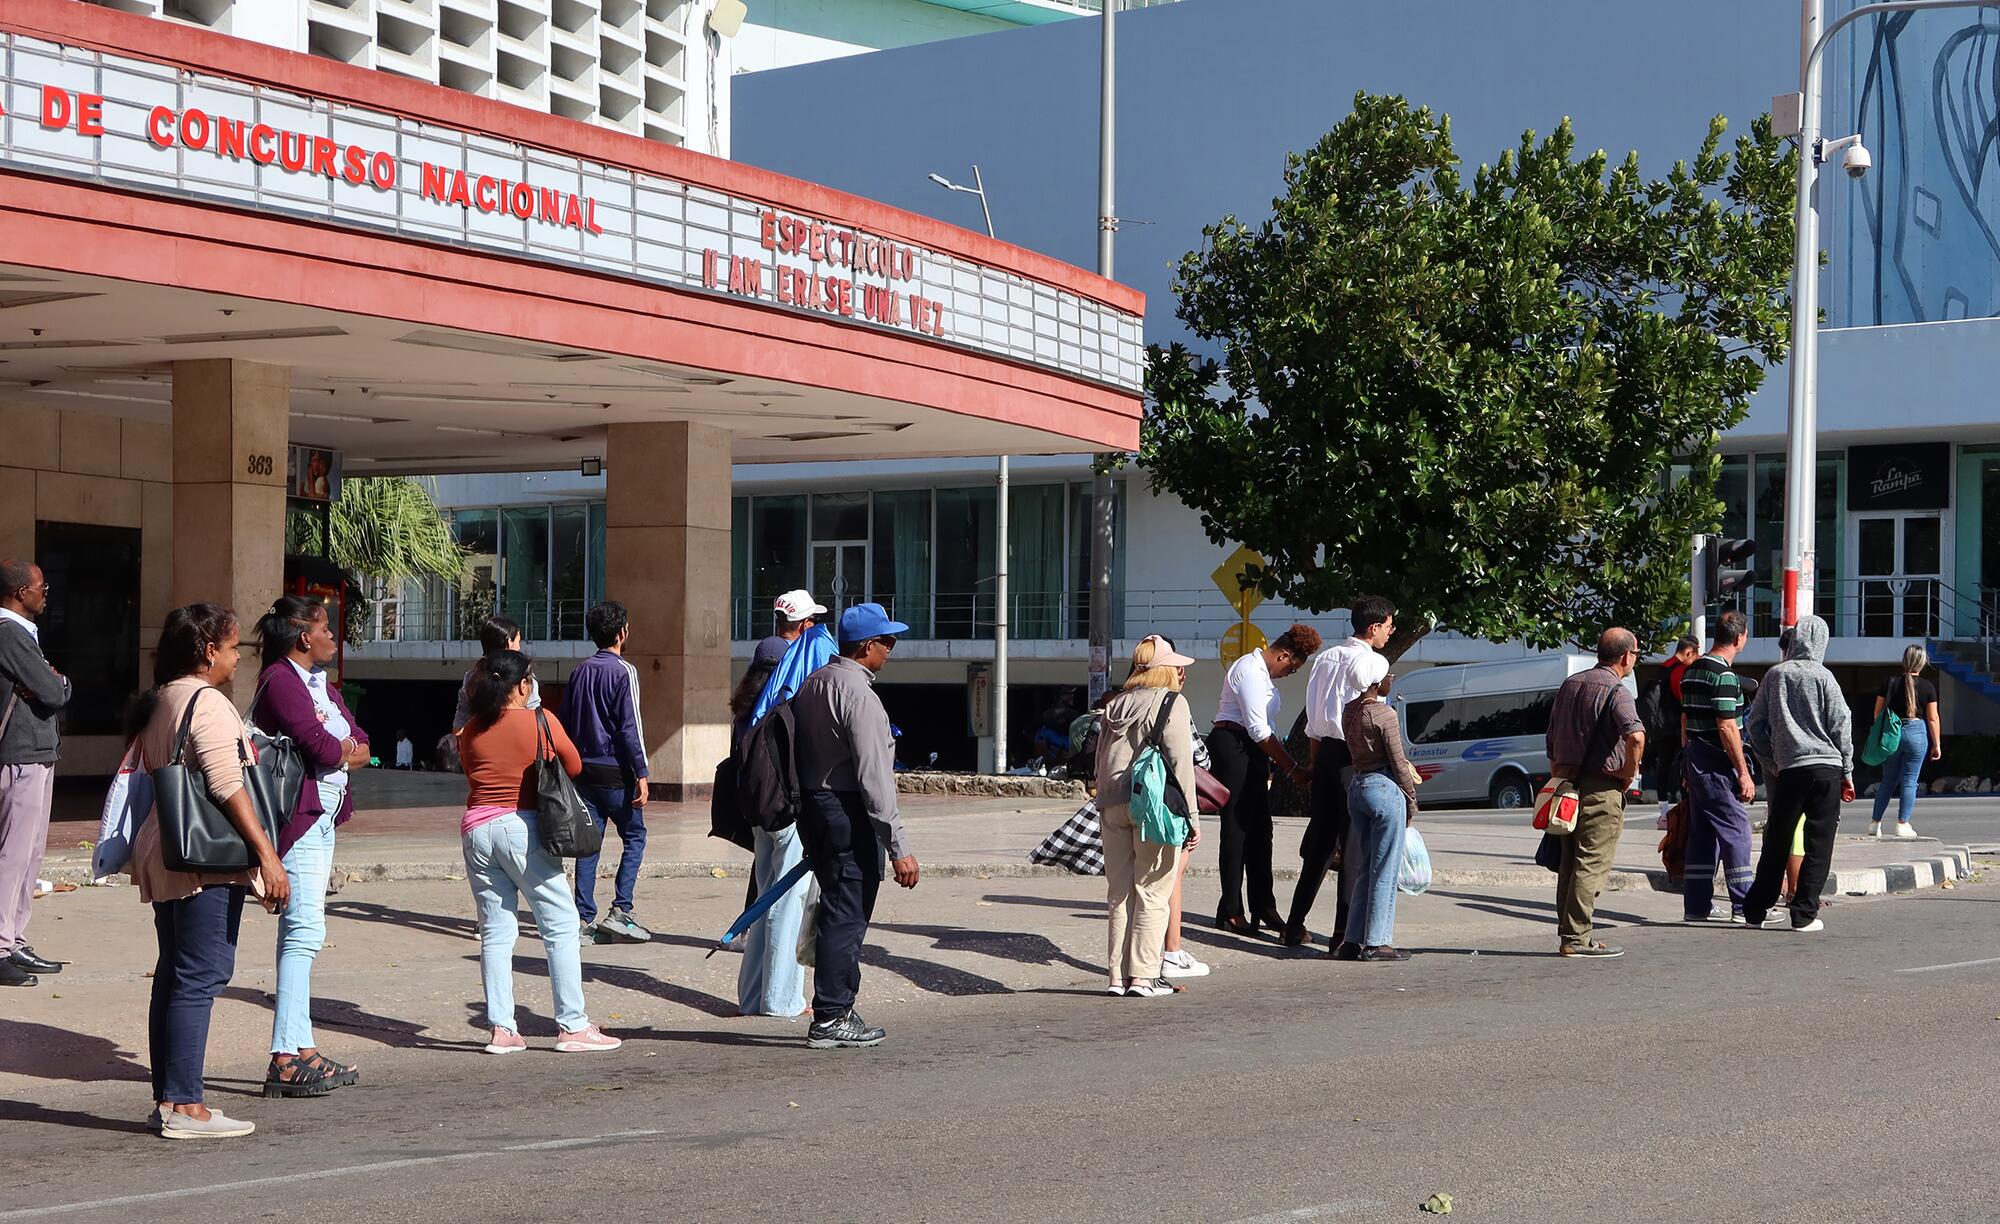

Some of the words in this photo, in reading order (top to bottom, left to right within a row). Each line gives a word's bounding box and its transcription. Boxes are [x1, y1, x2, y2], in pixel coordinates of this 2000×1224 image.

[41, 84, 105, 136] DE
[147, 104, 397, 190] CONCURSO
[421, 161, 604, 235] NACIONAL
[761, 211, 914, 282] ESPECTACULO
[728, 254, 762, 297] AM
[778, 264, 853, 316] ERASE
[863, 283, 901, 326] UNA
[909, 294, 944, 337] VEZ
[247, 454, 273, 476] 363
[1870, 474, 1923, 495] Rampa
[1885, 467, 1904, 482] La
